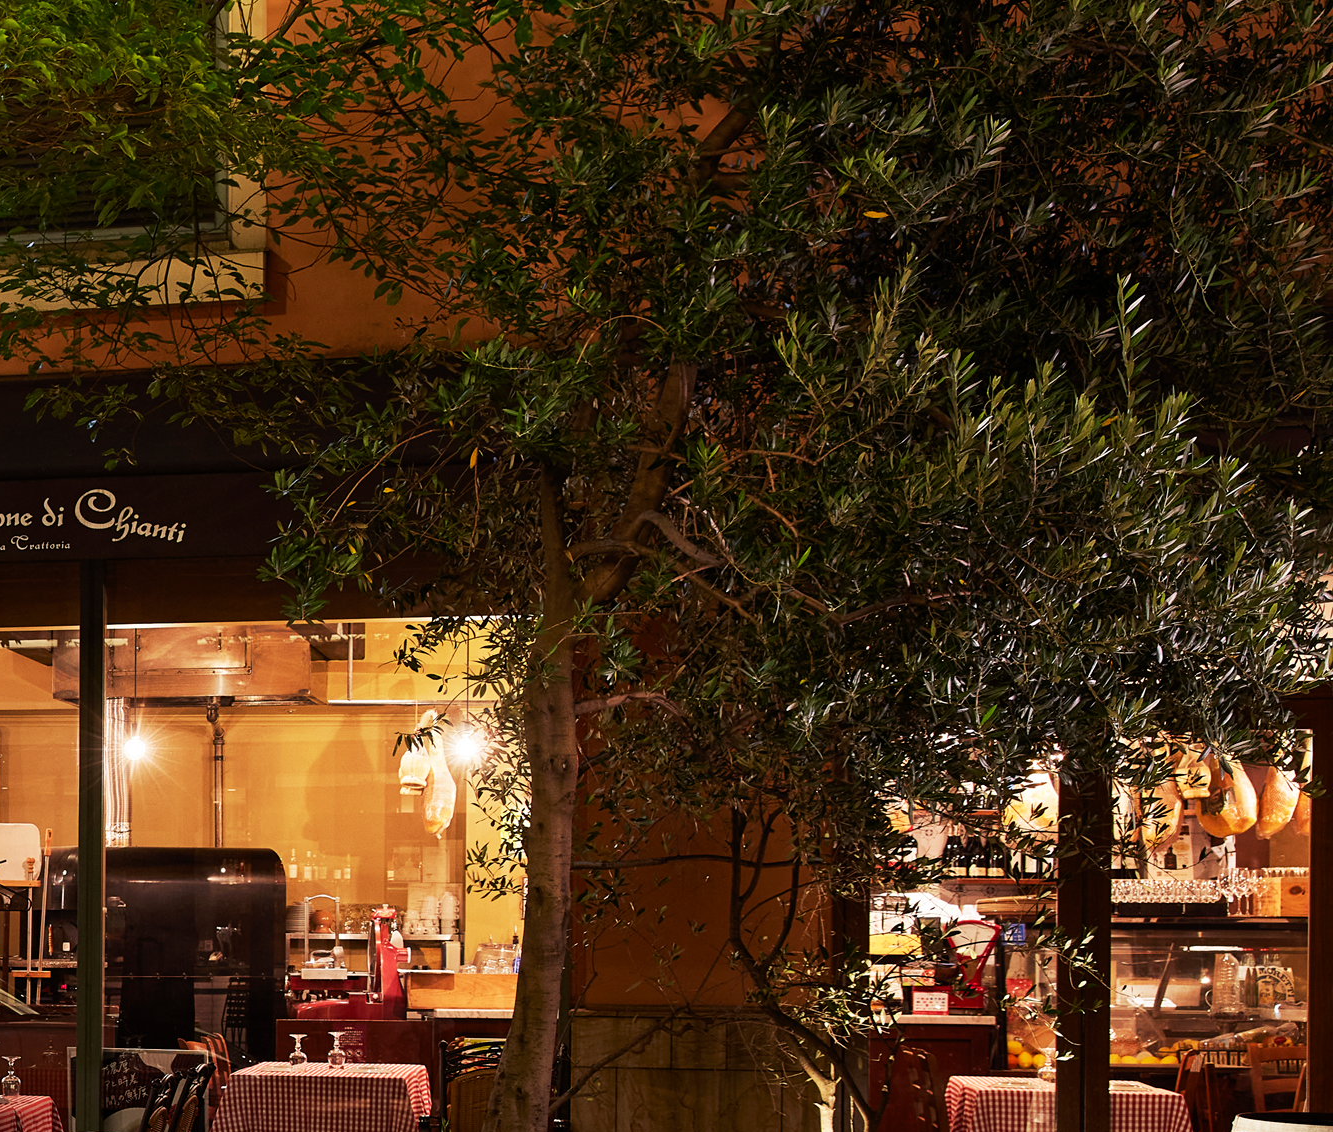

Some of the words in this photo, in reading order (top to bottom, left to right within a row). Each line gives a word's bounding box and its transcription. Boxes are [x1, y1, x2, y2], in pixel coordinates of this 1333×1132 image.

[42, 498, 65, 527] di
[75, 489, 187, 544] Chianti
[11, 535, 72, 551] Trattoria
[1258, 967, 1295, 997] MORETTI
